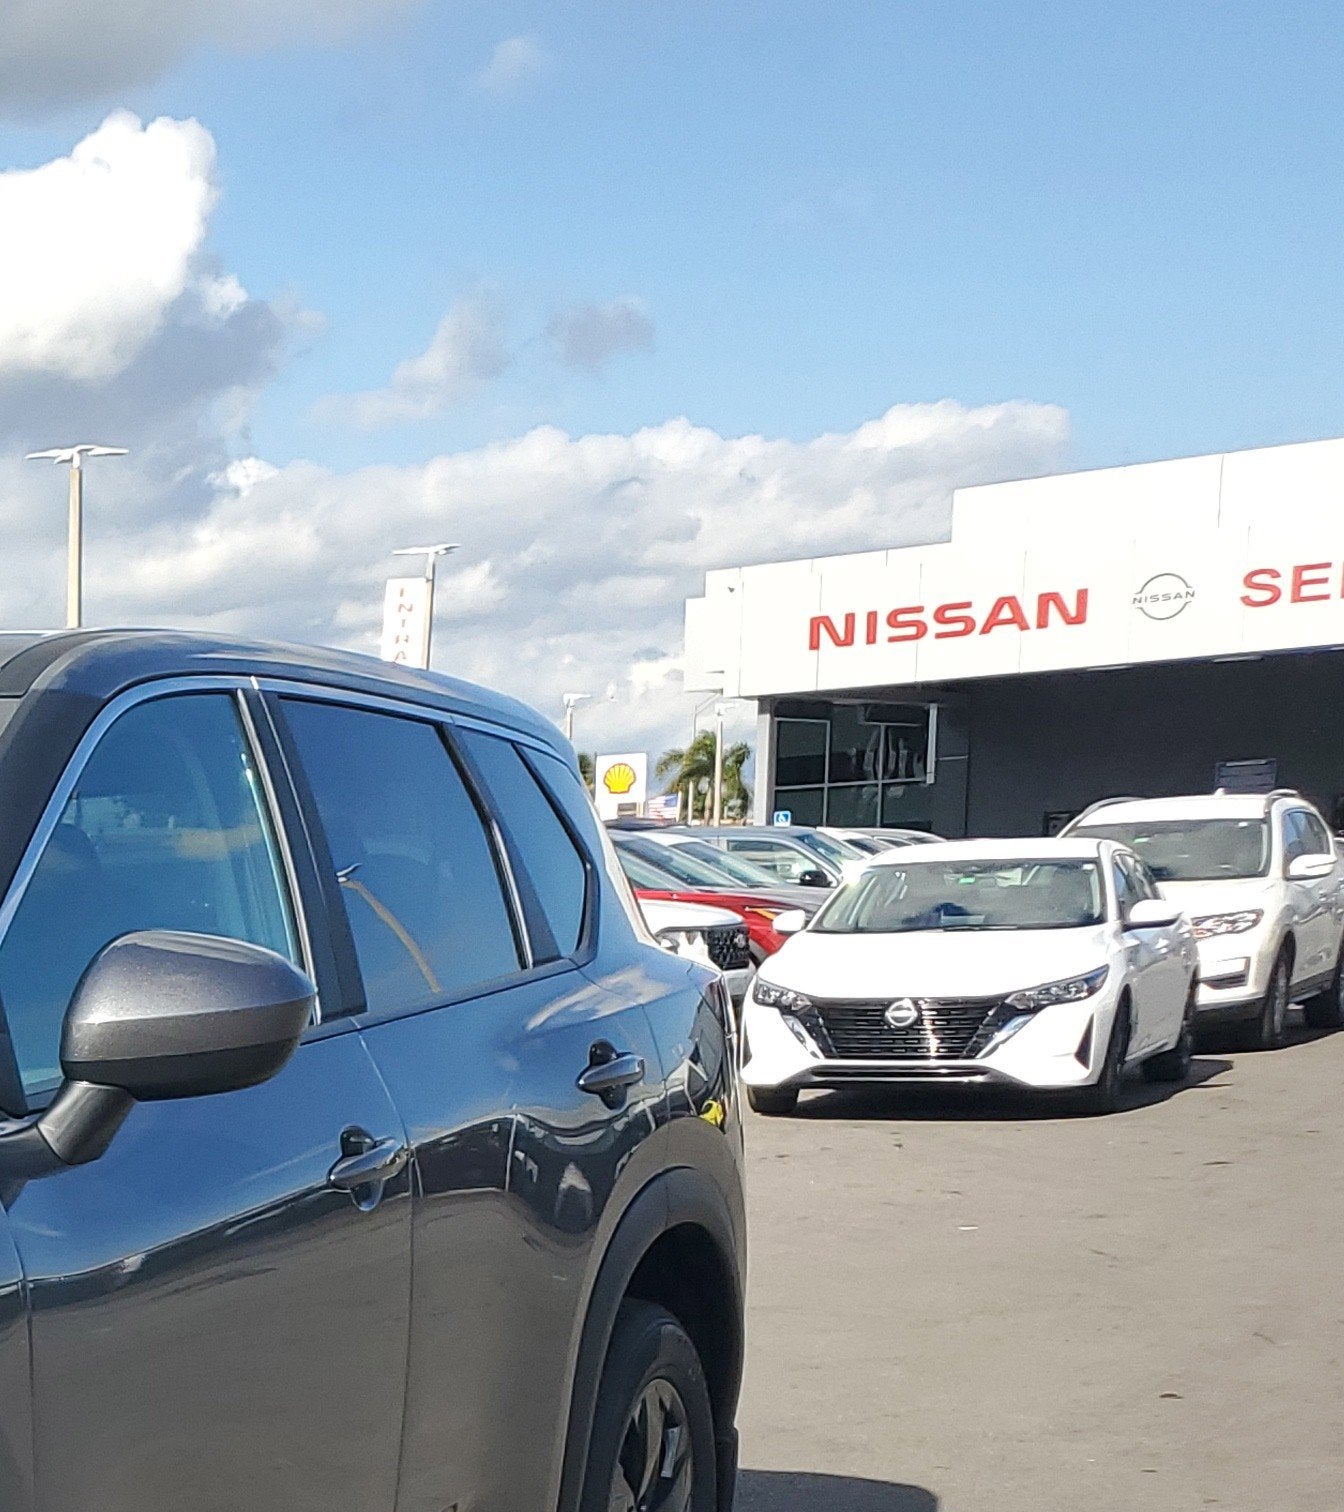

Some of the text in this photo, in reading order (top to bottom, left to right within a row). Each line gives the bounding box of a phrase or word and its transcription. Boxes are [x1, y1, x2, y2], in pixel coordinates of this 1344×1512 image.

[1131, 590, 1195, 604] NISSAN
[1239, 560, 1344, 608] SE
[808, 588, 1089, 651] NISSAN
